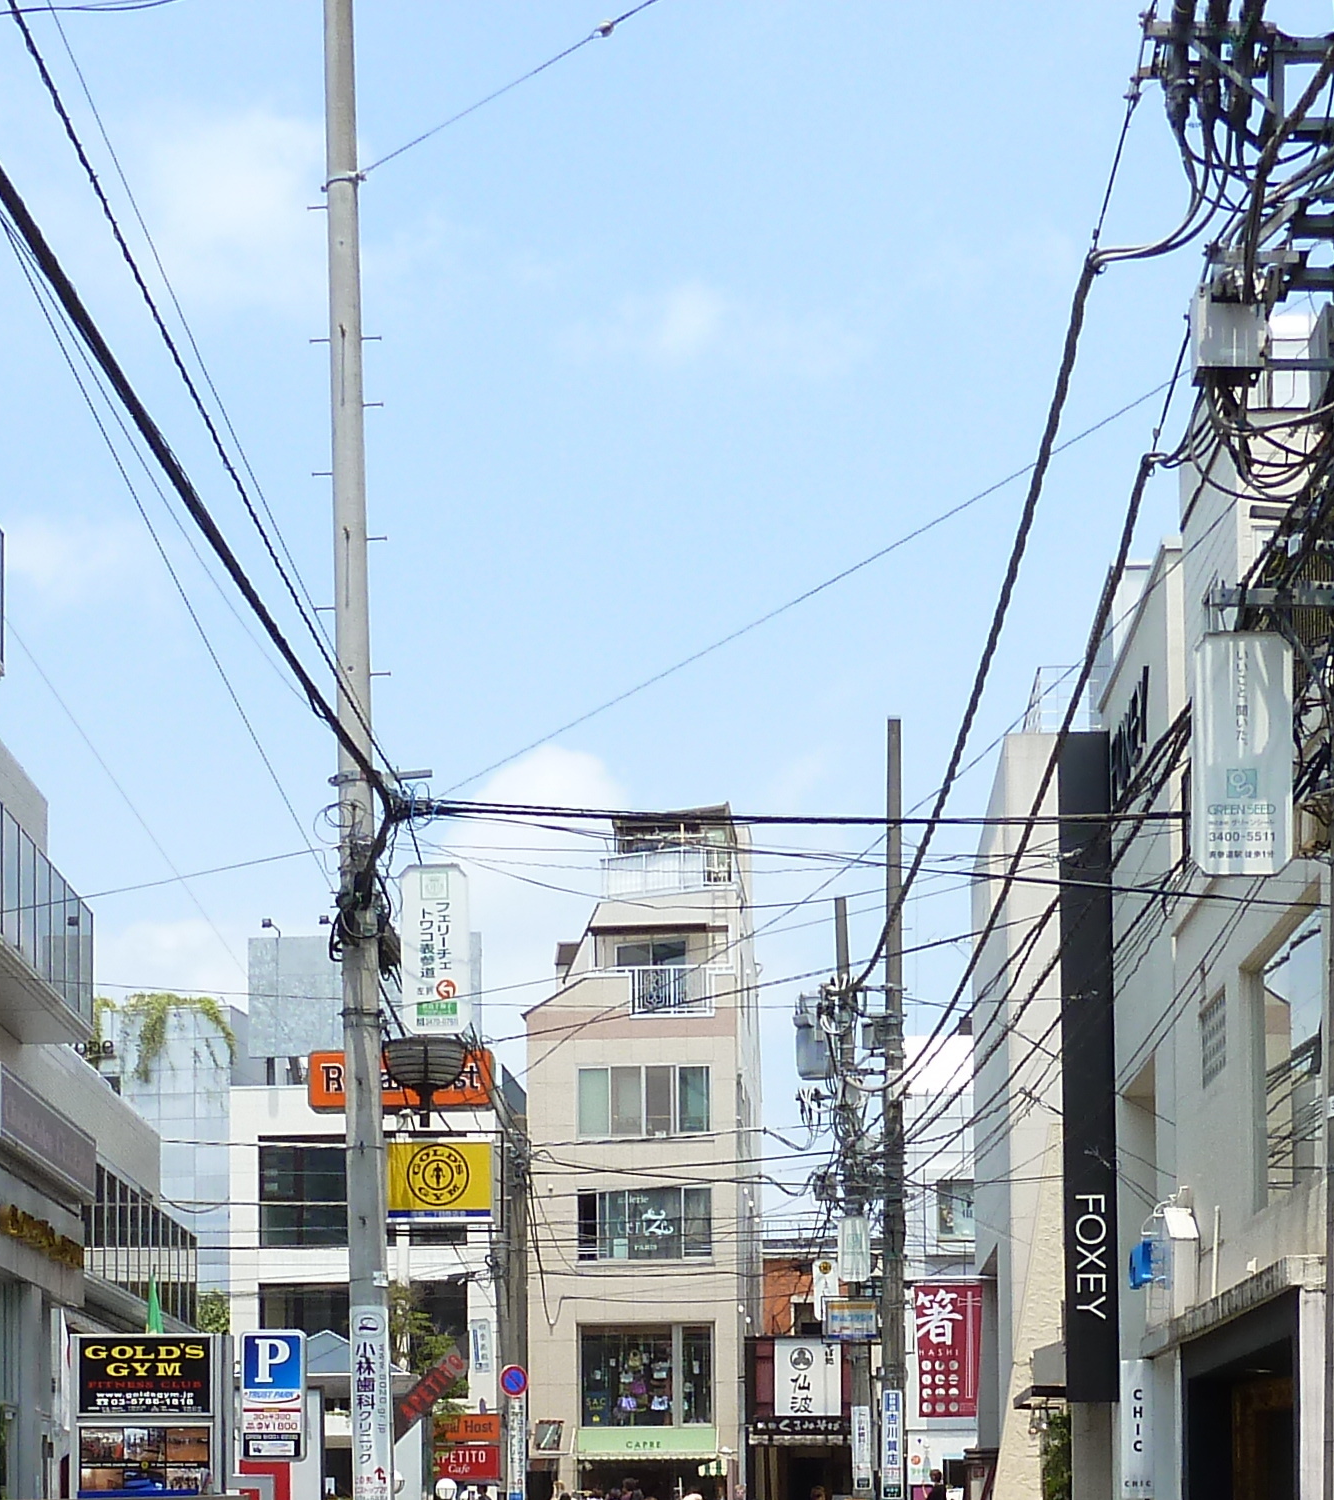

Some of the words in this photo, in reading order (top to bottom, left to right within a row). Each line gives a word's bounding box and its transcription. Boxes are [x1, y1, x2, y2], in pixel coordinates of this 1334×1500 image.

[1207, 804, 1245, 816] GREEN
[1246, 804, 1276, 816] SEED
[1208, 831, 1276, 843] 3400-5511
[419, 907, 436, 979] トワコ表参道
[435, 901, 453, 971] フェリーチェ
[412, 1148, 464, 1177] GOLD'S
[417, 1183, 461, 1201] GYM
[1075, 1194, 1107, 1320] FOXEY
[916, 1288, 964, 1346] 箸
[84, 1342, 205, 1360] GOLD'S
[918, 1349, 960, 1357] HASHI
[105, 1362, 183, 1377] GYM
[254, 1338, 291, 1383] P
[87, 1380, 155, 1389] FITNESS
[160, 1380, 203, 1389] CLUB
[400, 1353, 465, 1422] APETITO
[464, 1419, 493, 1435] Host
[1132, 1388, 1143, 1453] CHIC
[625, 1440, 661, 1449] CAPRE
[448, 1464, 471, 1477] Cafe
[1124, 1480, 1152, 1488] CHIC
